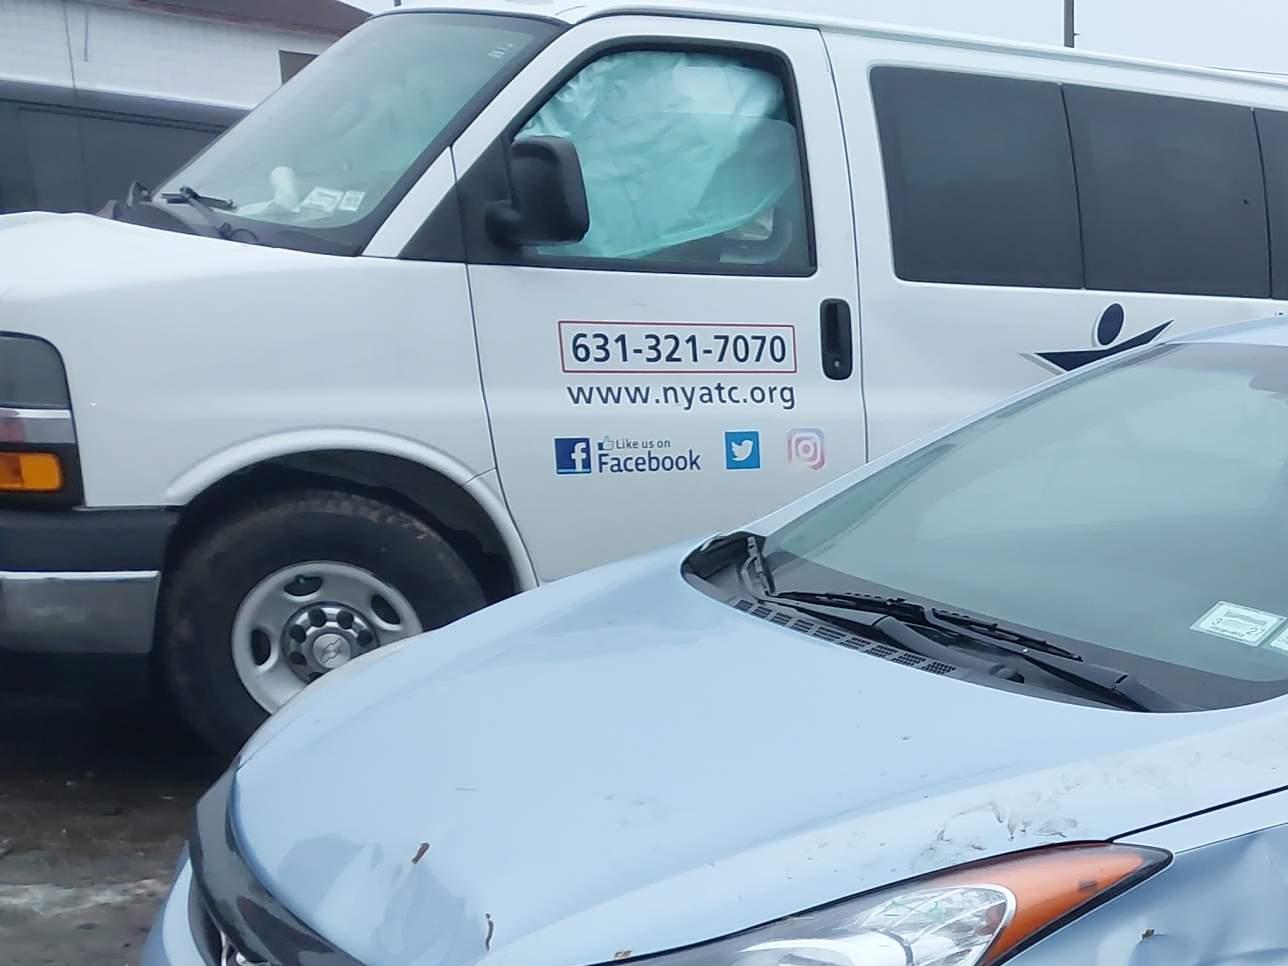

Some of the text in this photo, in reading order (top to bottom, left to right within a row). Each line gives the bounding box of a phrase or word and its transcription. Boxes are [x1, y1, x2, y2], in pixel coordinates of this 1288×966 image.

[571, 333, 787, 363] 631-321-7070
[567, 382, 796, 409] www.nyatc.org
[615, 438, 671, 449] Like us on
[598, 449, 701, 473] Facebook
